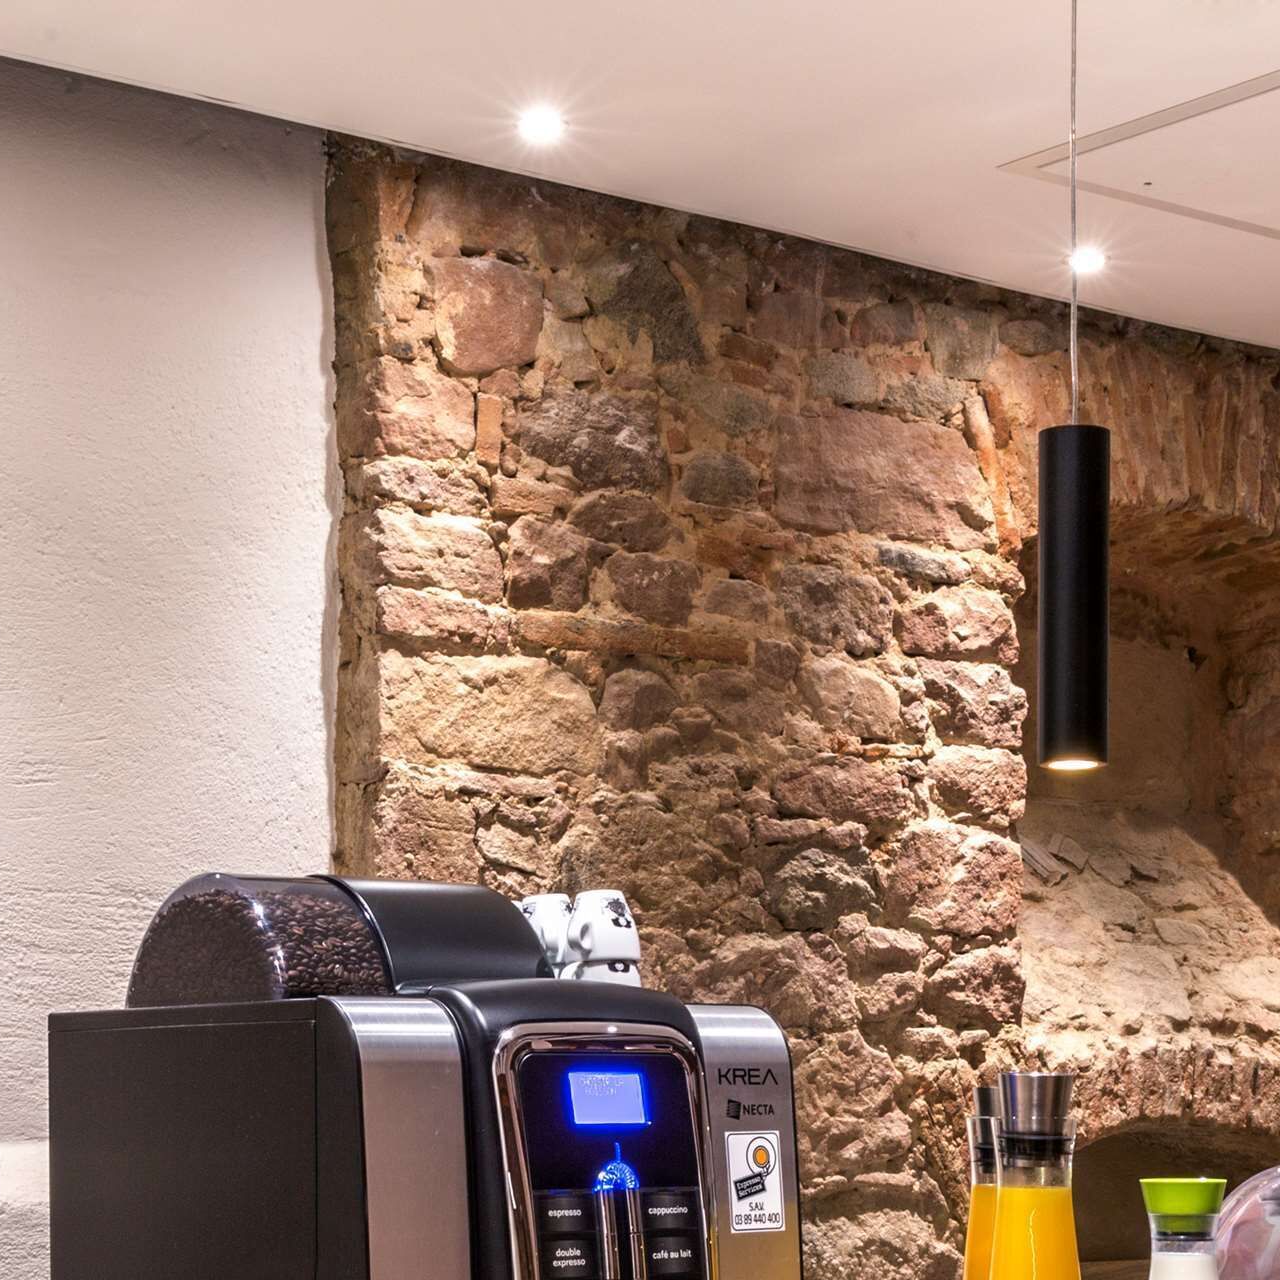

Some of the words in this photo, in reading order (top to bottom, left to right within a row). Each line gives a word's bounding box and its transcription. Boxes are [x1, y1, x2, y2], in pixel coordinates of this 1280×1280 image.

[742, 1103, 775, 1115] NECTA
[548, 1209, 582, 1218] espresso
[648, 1206, 688, 1217] cappuccino
[735, 1213, 743, 1225] 03
[744, 1213, 752, 1225] 89
[753, 1213, 766, 1224] 440
[767, 1212, 780, 1223] 400
[555, 1248, 581, 1257] double
[652, 1250, 669, 1260] café
[670, 1251, 679, 1259] au
[680, 1249, 692, 1258] lait
